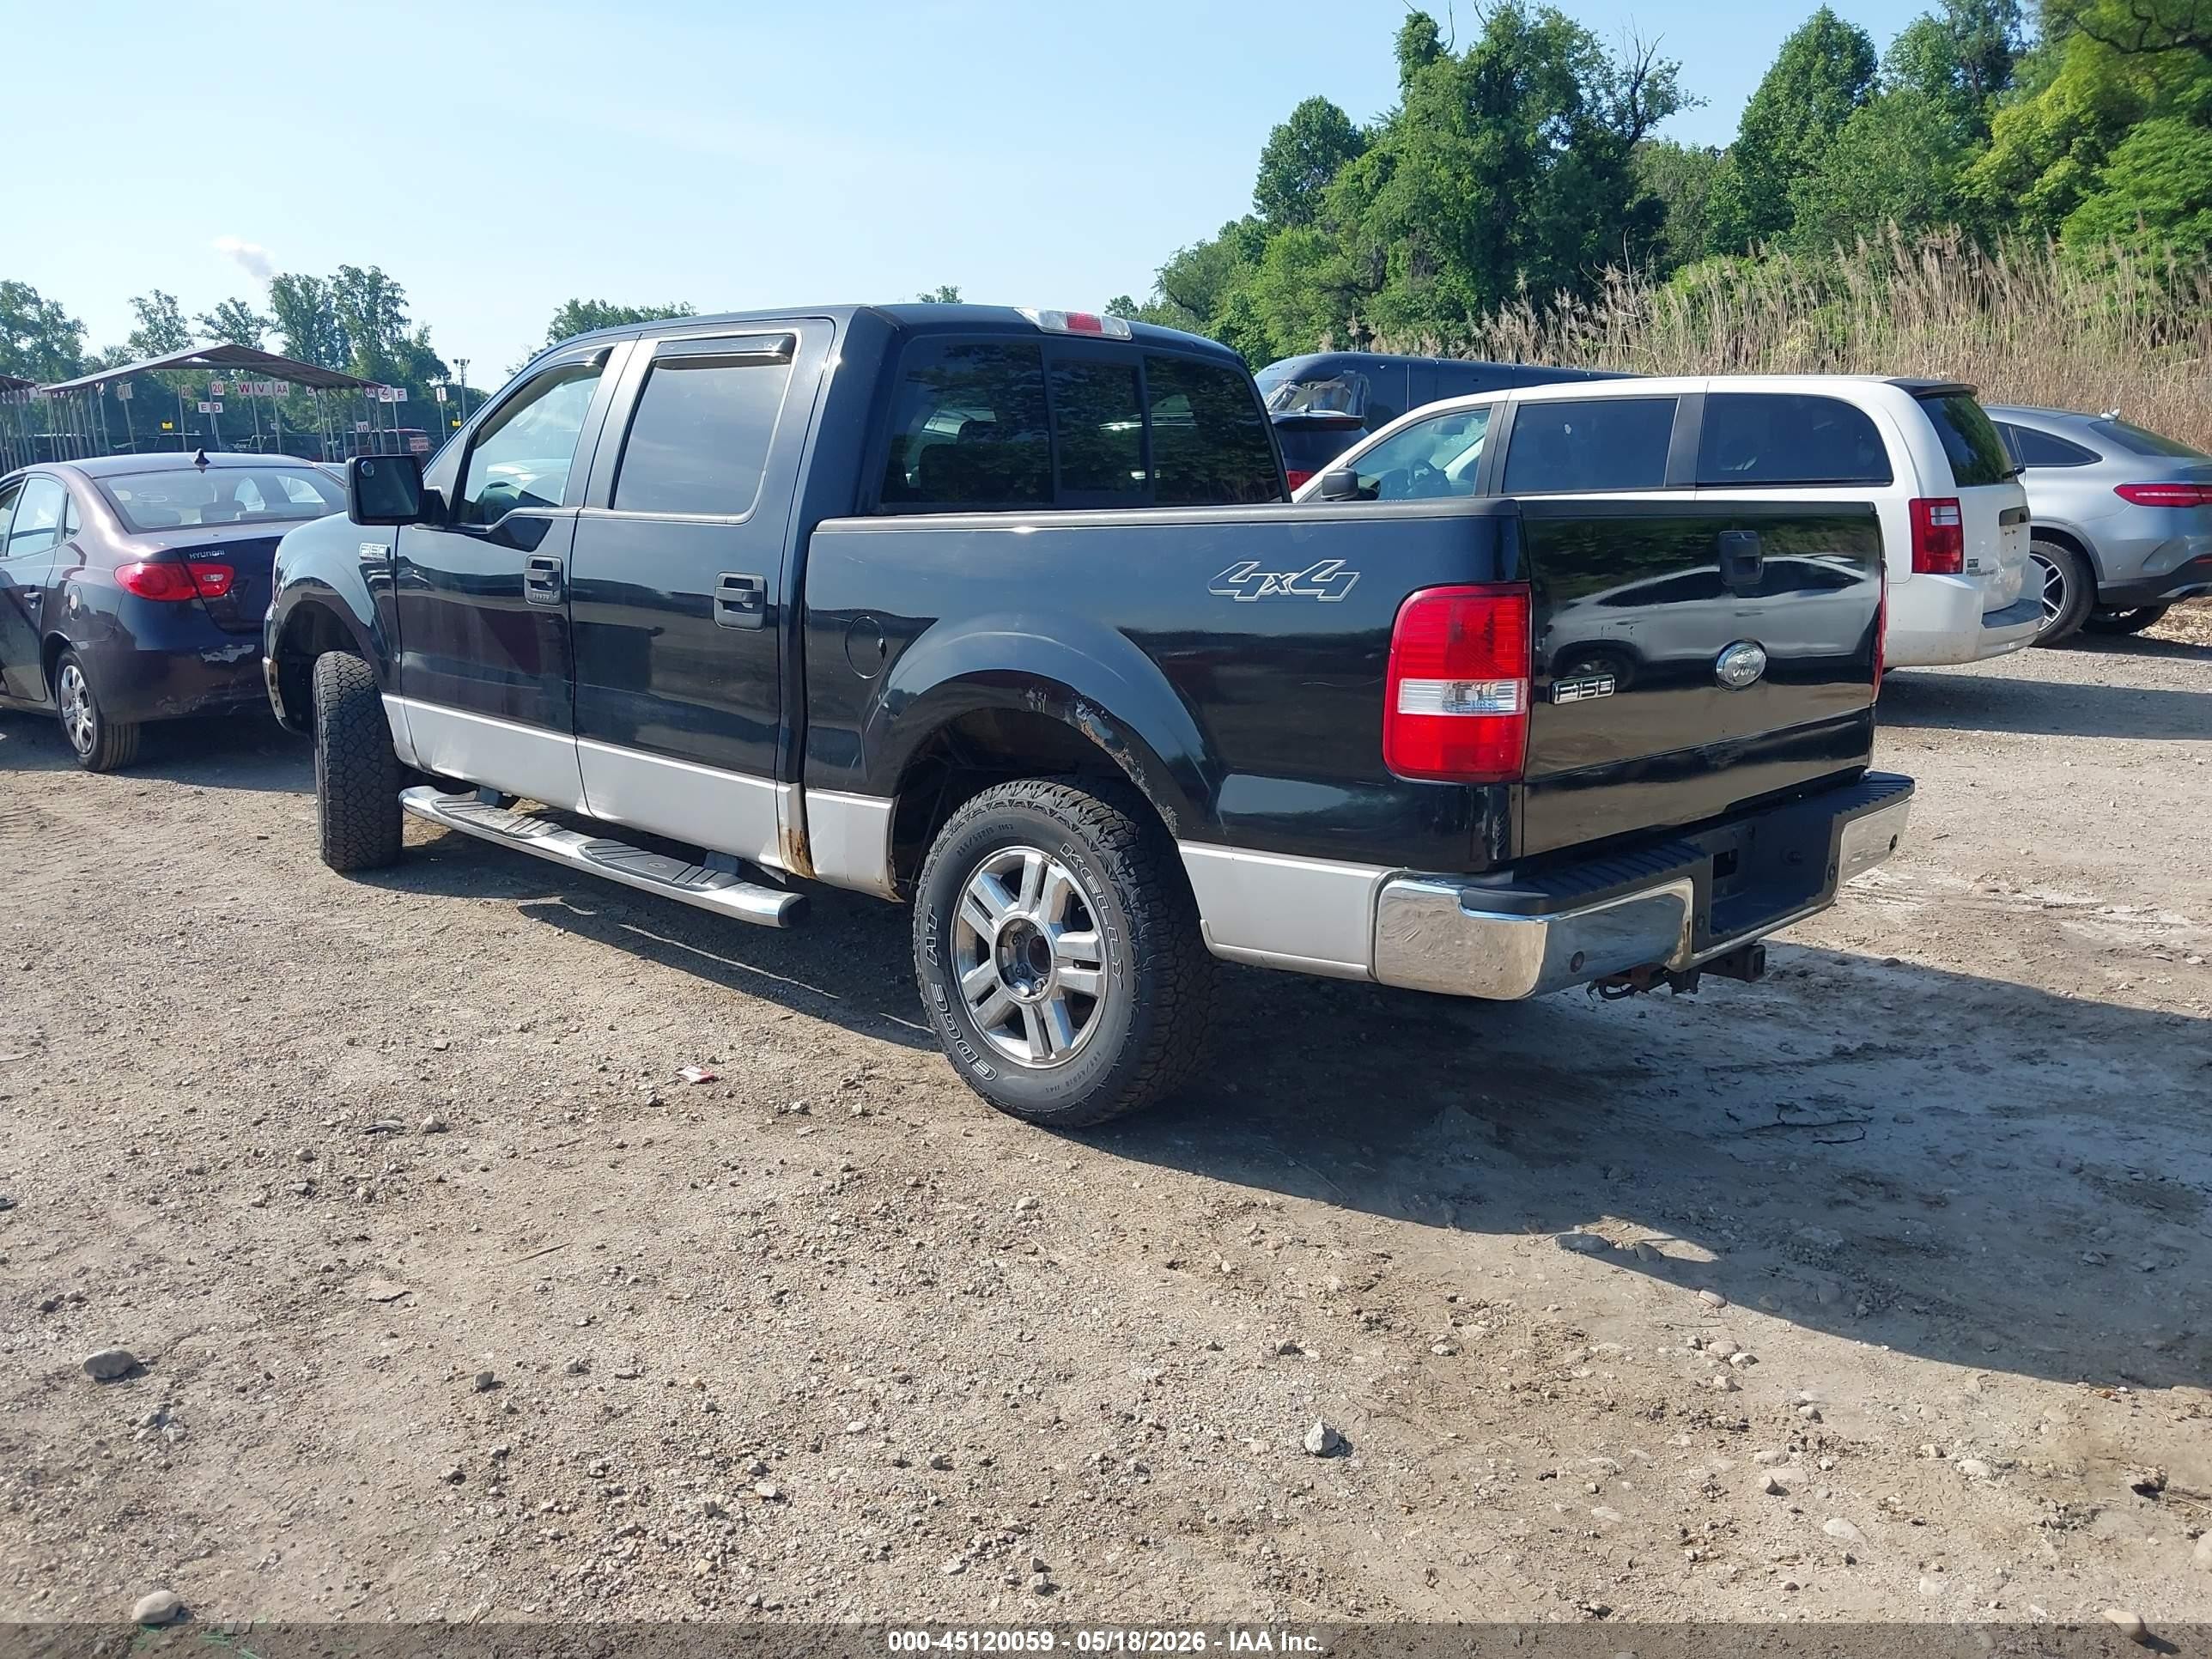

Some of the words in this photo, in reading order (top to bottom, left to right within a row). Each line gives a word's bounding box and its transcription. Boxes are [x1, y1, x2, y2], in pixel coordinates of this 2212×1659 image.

[213, 384, 222, 393] 20
[239, 384, 250, 393] W
[258, 384, 264, 392] V
[276, 384, 288, 393] AA
[397, 390, 404, 399] F
[189, 550, 225, 560] HYUNDAI
[1208, 559, 1361, 602] 4x4
[1060, 842, 1124, 991] KELLY
[924, 903, 941, 968] AT
[929, 981, 998, 1082] EDGE
